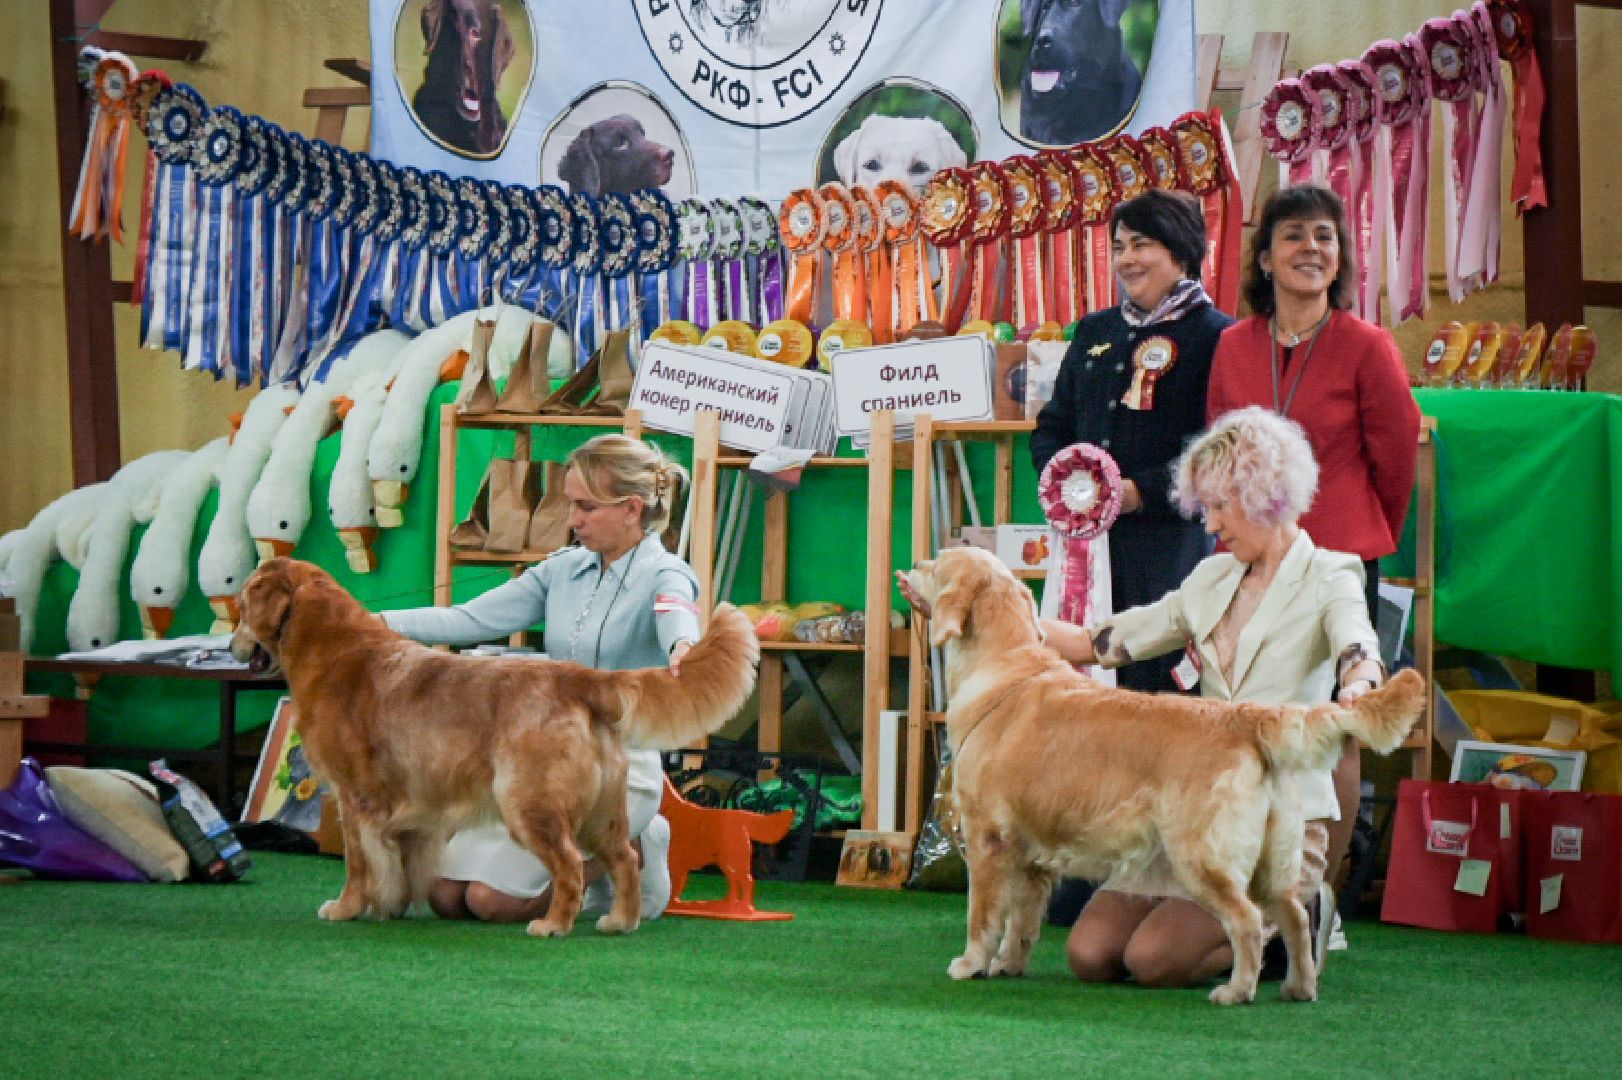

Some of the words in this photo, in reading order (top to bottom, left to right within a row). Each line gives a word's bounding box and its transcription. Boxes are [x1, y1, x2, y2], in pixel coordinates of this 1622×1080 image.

[771, 59, 823, 109] FCI
[649, 359, 780, 405] Американский
[880, 363, 939, 383] Филд
[640, 388, 690, 415] кокер
[860, 388, 962, 413] спаниель
